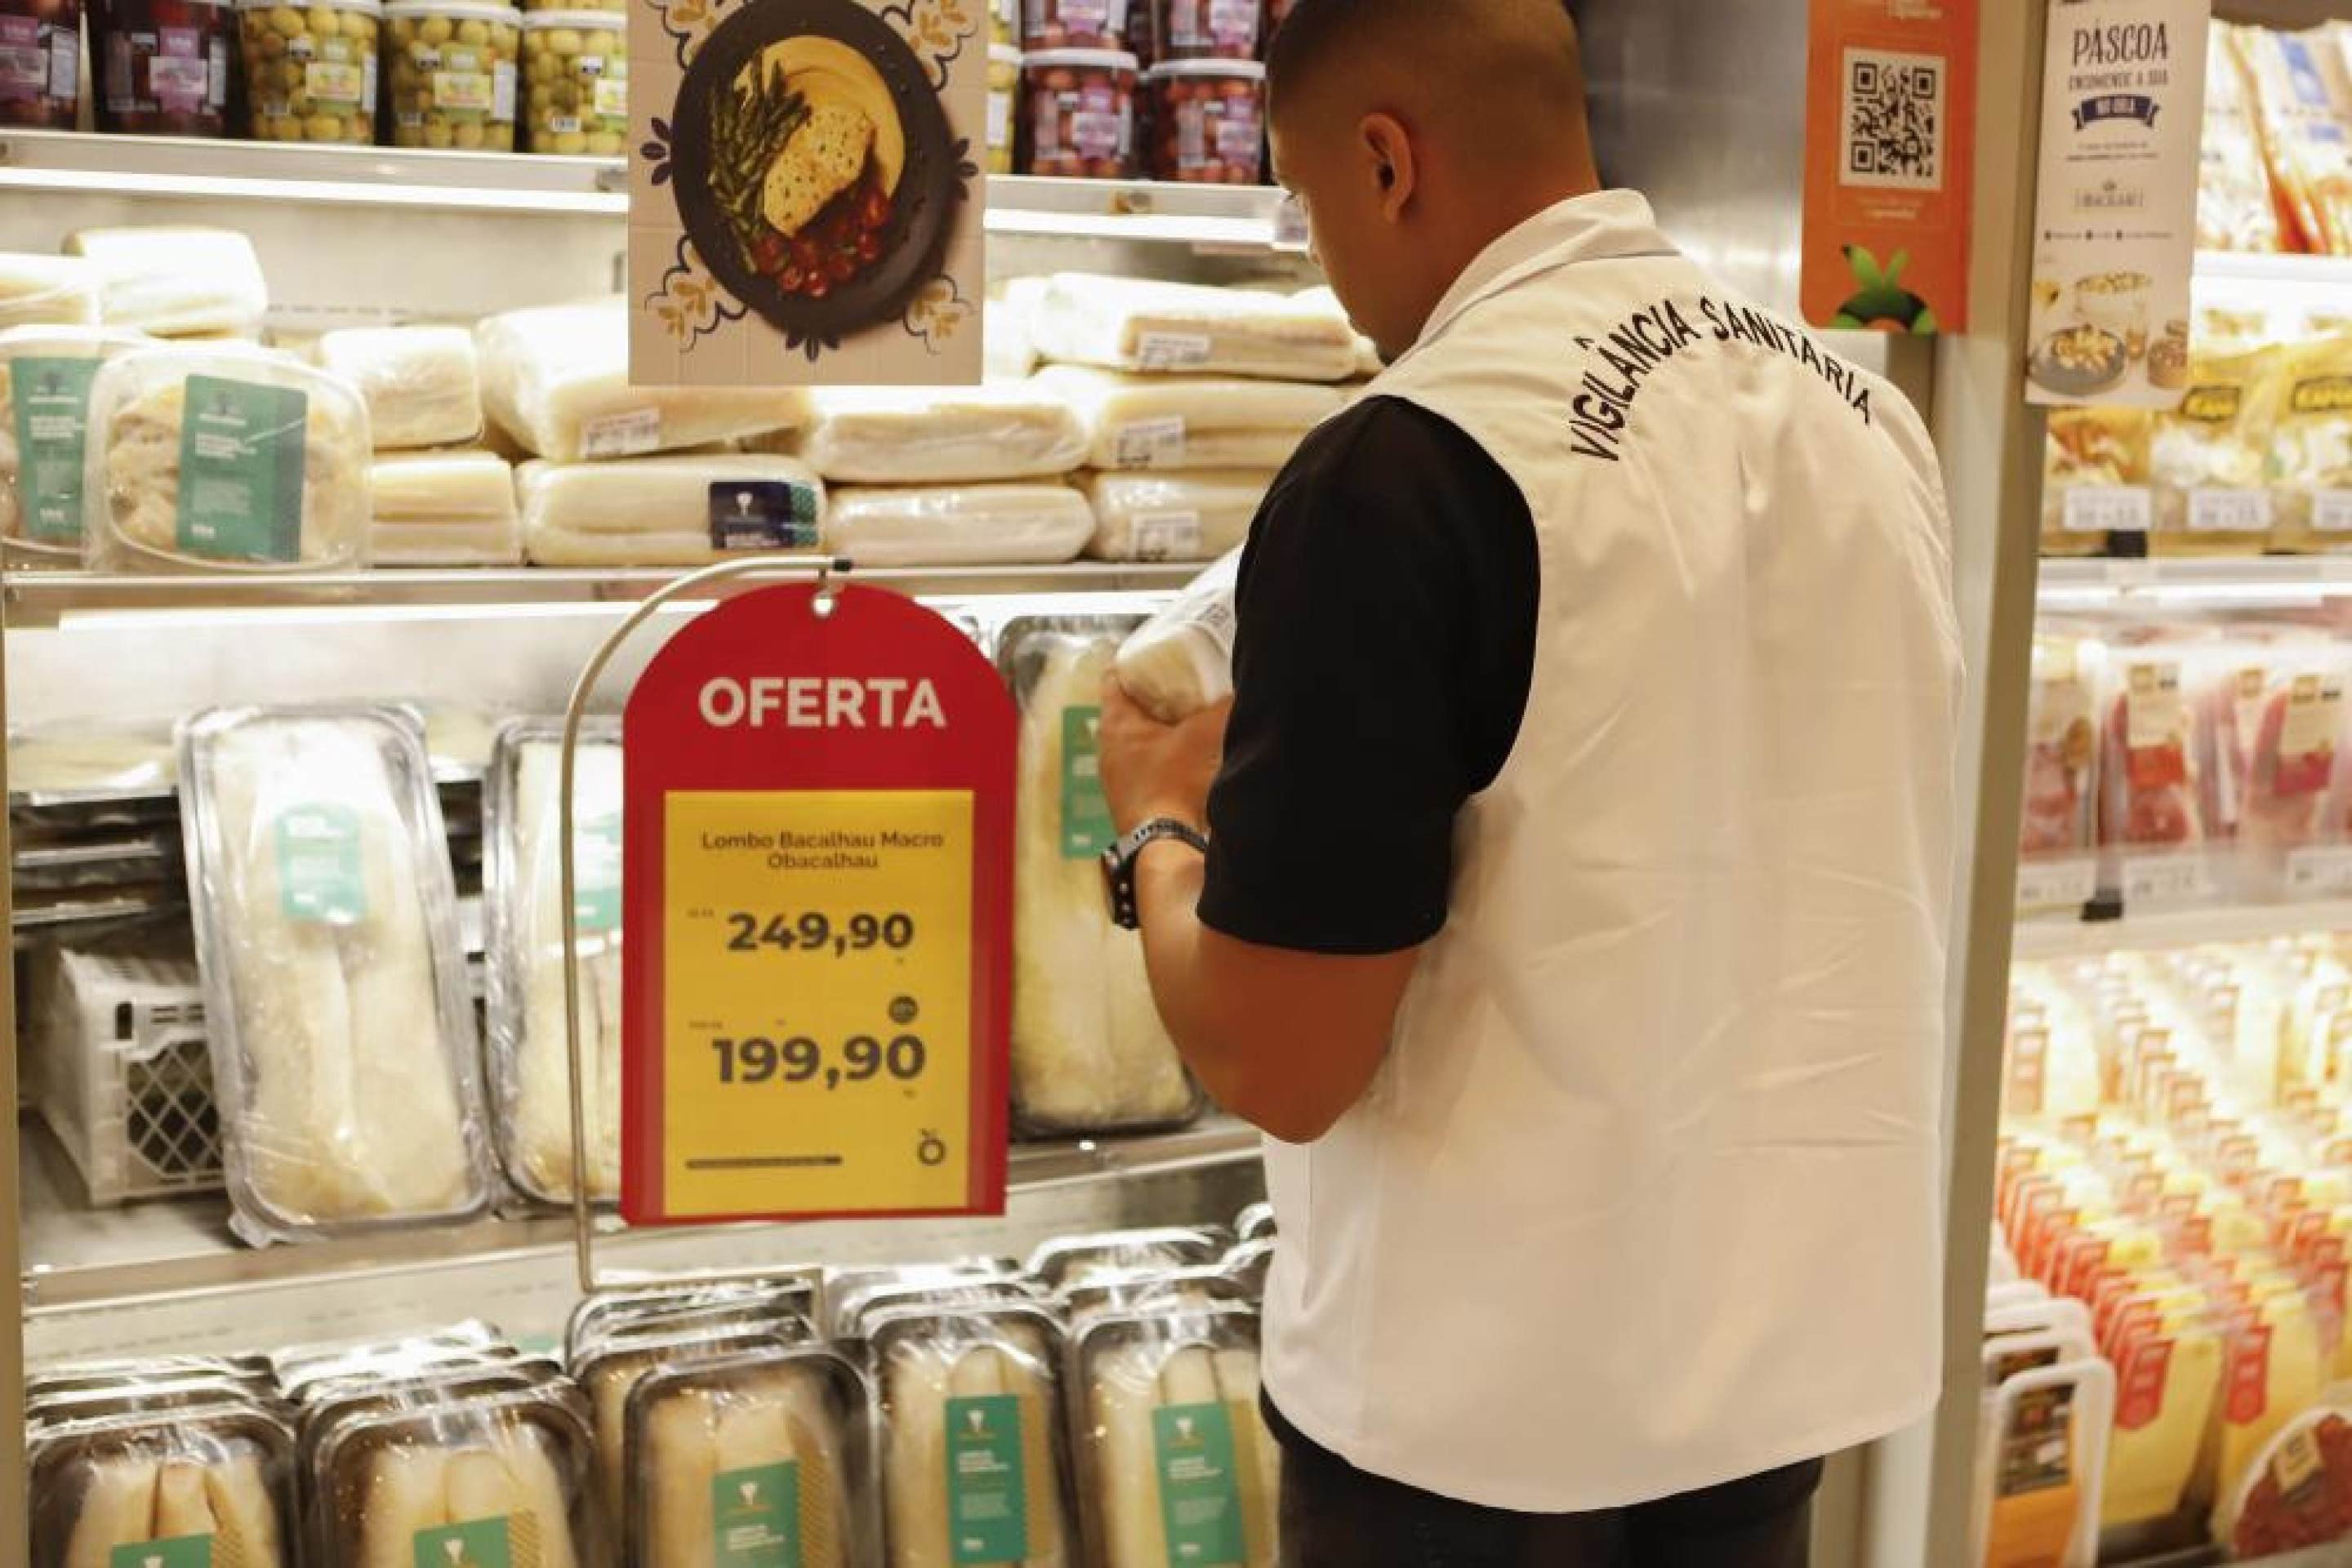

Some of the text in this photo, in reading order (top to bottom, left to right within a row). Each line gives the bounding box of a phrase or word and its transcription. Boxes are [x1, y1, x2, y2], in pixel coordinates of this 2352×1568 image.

[1569, 299, 1702, 461] VIGILÂNCIA
[697, 676, 947, 728] OFERTA
[702, 831, 944, 850] Lombo Bacalhau Macro
[766, 852, 878, 869] Obacalhau
[727, 911, 914, 959] 249,90
[711, 1034, 926, 1091] 199,90
